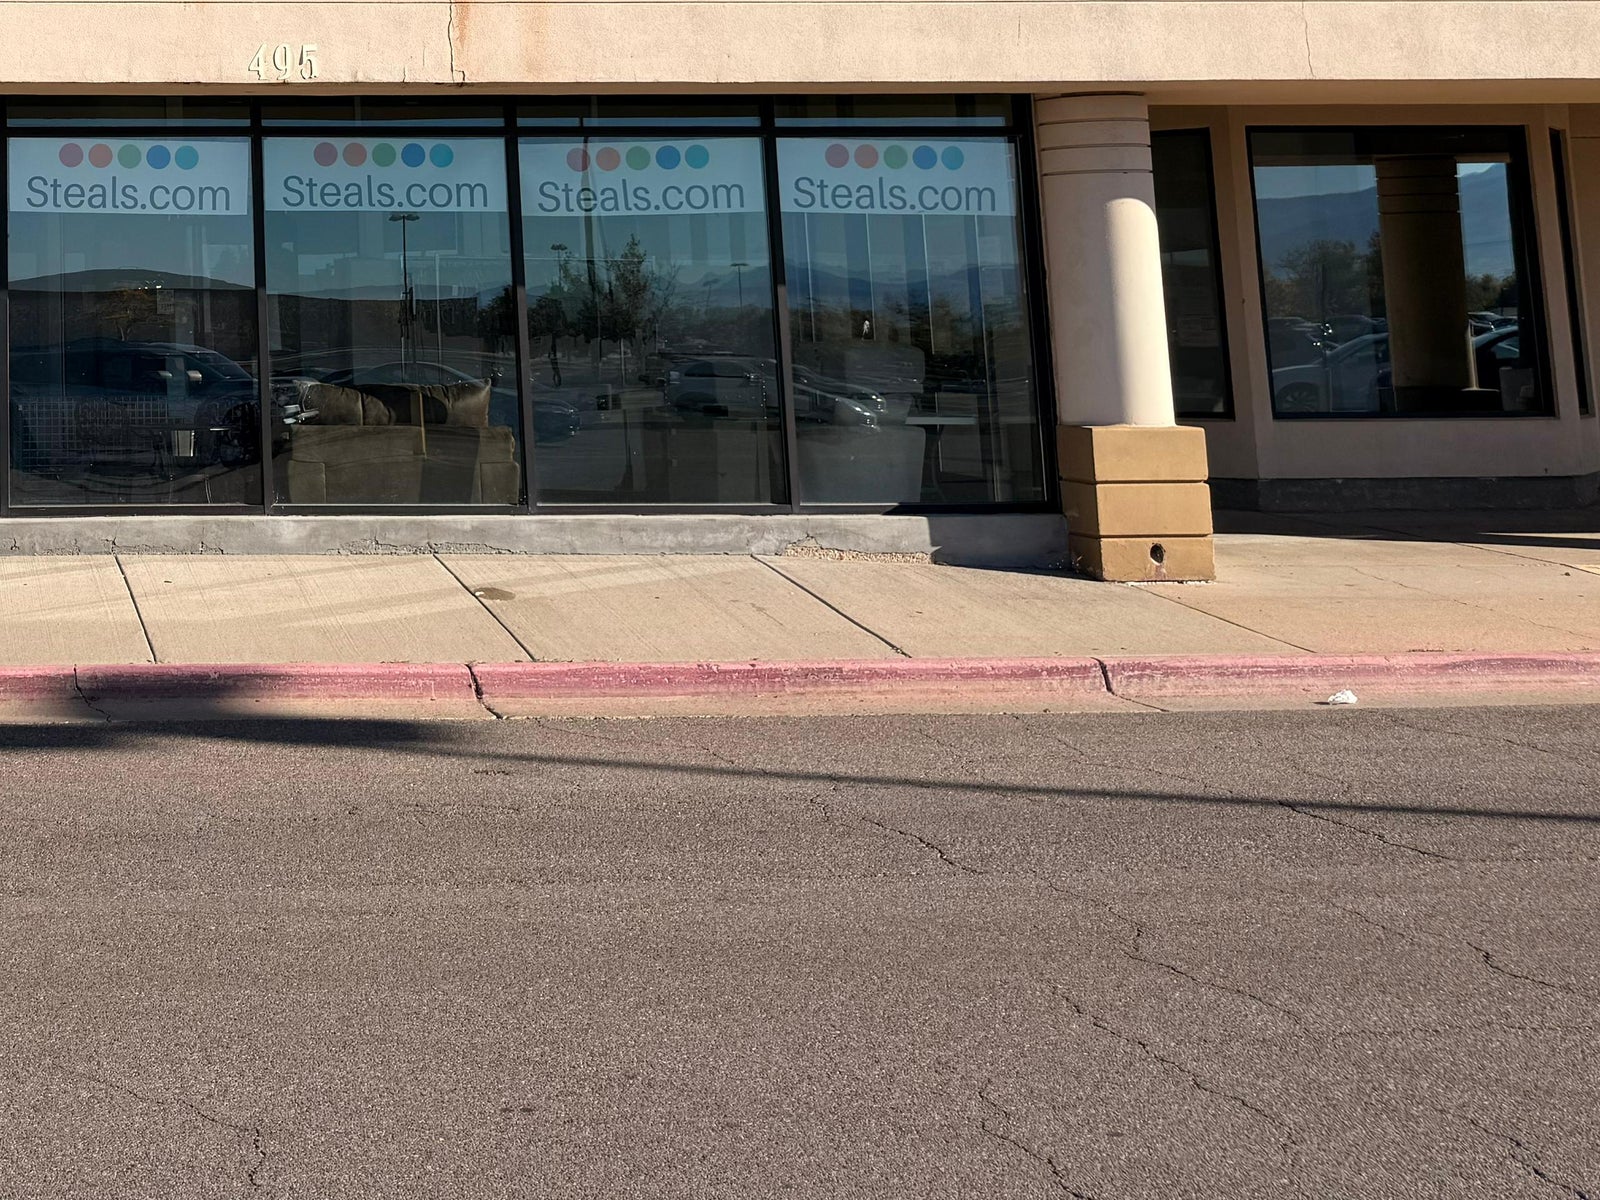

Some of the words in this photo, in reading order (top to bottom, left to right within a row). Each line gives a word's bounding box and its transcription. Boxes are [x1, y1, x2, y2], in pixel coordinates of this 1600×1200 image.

[247, 42, 320, 81] 495
[25, 173, 232, 212] Steals.com
[282, 173, 489, 208] Steals.com
[538, 178, 745, 213] Steals.com
[793, 175, 997, 212] Steals.com
